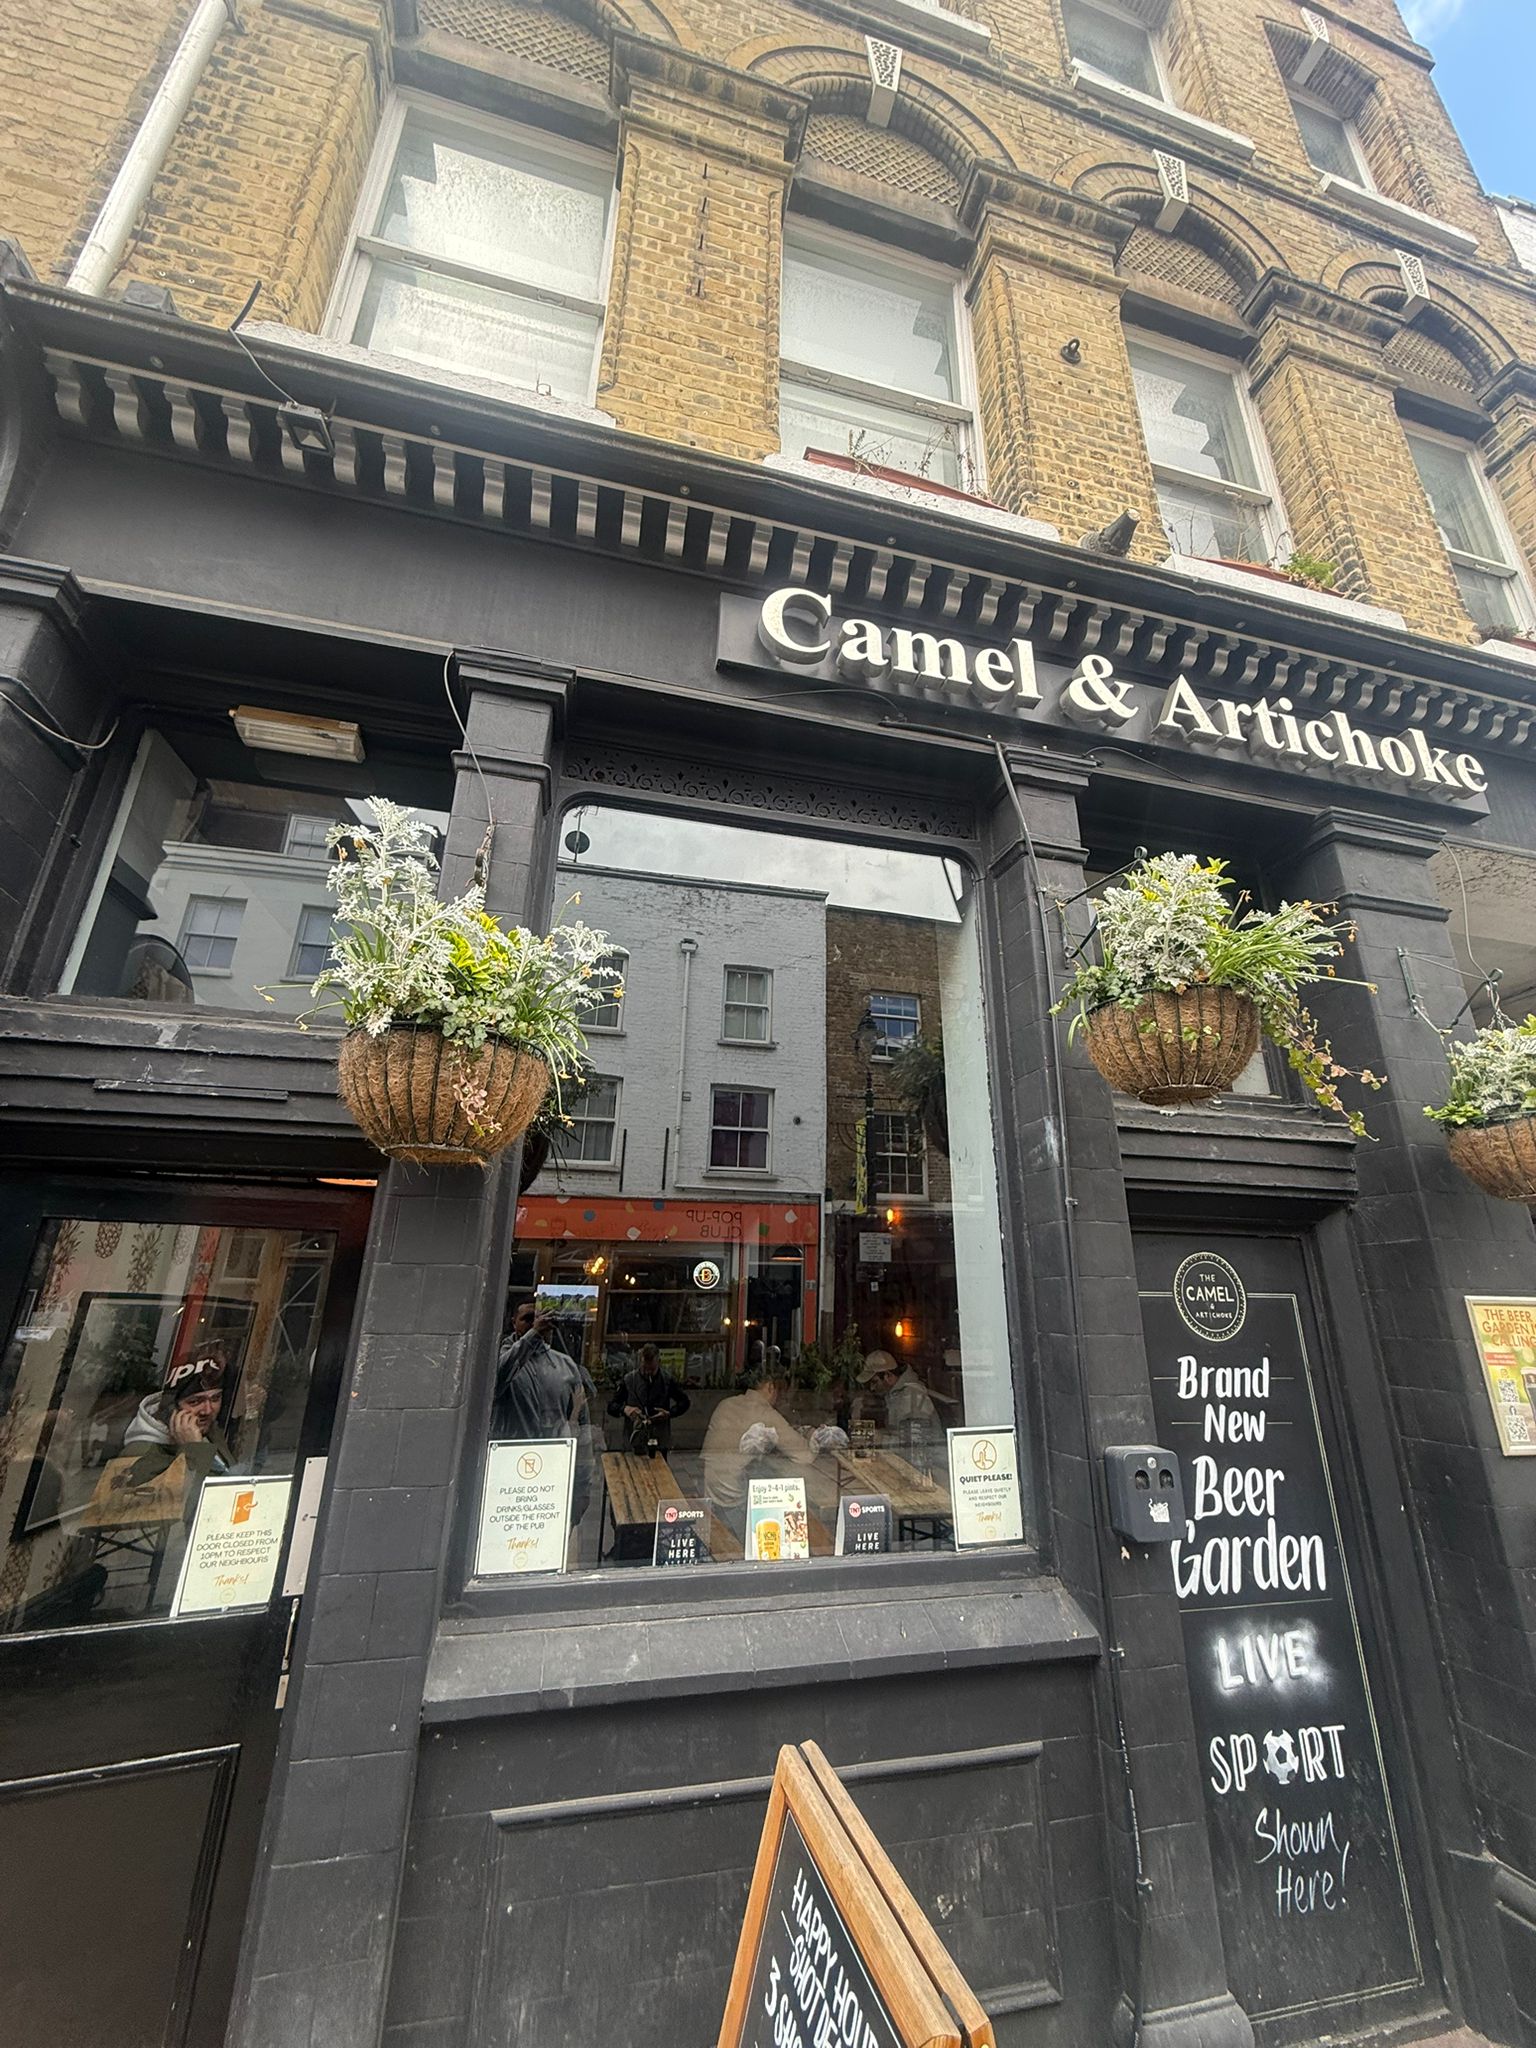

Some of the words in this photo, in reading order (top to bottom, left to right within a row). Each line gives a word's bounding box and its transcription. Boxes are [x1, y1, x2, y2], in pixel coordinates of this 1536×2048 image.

[760, 587, 1044, 702] Camel
[1067, 653, 1139, 721] &
[1158, 673, 1489, 795] Artichoke
[1199, 1273, 1216, 1282] THE
[1186, 1286, 1235, 1302] CAMEL
[1484, 1308, 1506, 1321] THE
[1507, 1309, 1533, 1322] BEER
[1482, 1320, 1529, 1335] GARDEN
[1177, 1355, 1270, 1400] Brand
[1203, 1403, 1266, 1443] New
[959, 1475, 982, 1485] QUIET
[983, 1473, 1013, 1483] PLEASE!
[499, 1486, 526, 1495] PLEASE
[527, 1485, 539, 1494] DO
[539, 1484, 555, 1493] NOT
[752, 1484, 767, 1494] Enjoy
[768, 1484, 784, 1492] 2-4-1
[994, 1486, 1011, 1494] QUIETLY
[1191, 1454, 1286, 1521] Beer
[515, 1495, 538, 1503] BRING
[496, 1503, 556, 1514] DRINKS/GLASSES
[678, 1510, 704, 1519] SPORTS
[861, 1505, 885, 1514] SPORTS
[489, 1513, 522, 1523] OUTSIDE
[522, 1512, 536, 1521] THE
[536, 1511, 560, 1521] FRONT
[503, 1523, 514, 1532] OF
[515, 1522, 530, 1531] THE
[530, 1521, 545, 1531] PUB
[206, 1532, 235, 1542] PLEASE
[236, 1530, 255, 1539] KEEP
[256, 1528, 272, 1537] THIS
[857, 1532, 879, 1542] LIVE
[196, 1541, 221, 1552] DOOR
[222, 1539, 254, 1549] CLOSED
[254, 1537, 278, 1546] FROM
[670, 1538, 695, 1548] LIVE
[854, 1541, 880, 1551] HERE
[200, 1551, 223, 1560] 10PM
[224, 1549, 236, 1558] TO
[236, 1546, 271, 1556] RESPECT
[668, 1548, 696, 1559] HERE
[1170, 1517, 1327, 1599] Garden
[199, 1560, 218, 1569] OUR
[218, 1556, 269, 1567] NEIGHBOURS
[214, 1573, 250, 1587] Thanks!
[1216, 1630, 1309, 1691] LIVE
[1253, 1807, 1341, 1864] Shown
[1275, 1840, 1350, 1918] Here!
[791, 1867, 838, 1990] HAPPY
[764, 1954, 781, 2017] 3
[789, 1934, 826, 2028] SHOT
[813, 1999, 843, 2048] DE
